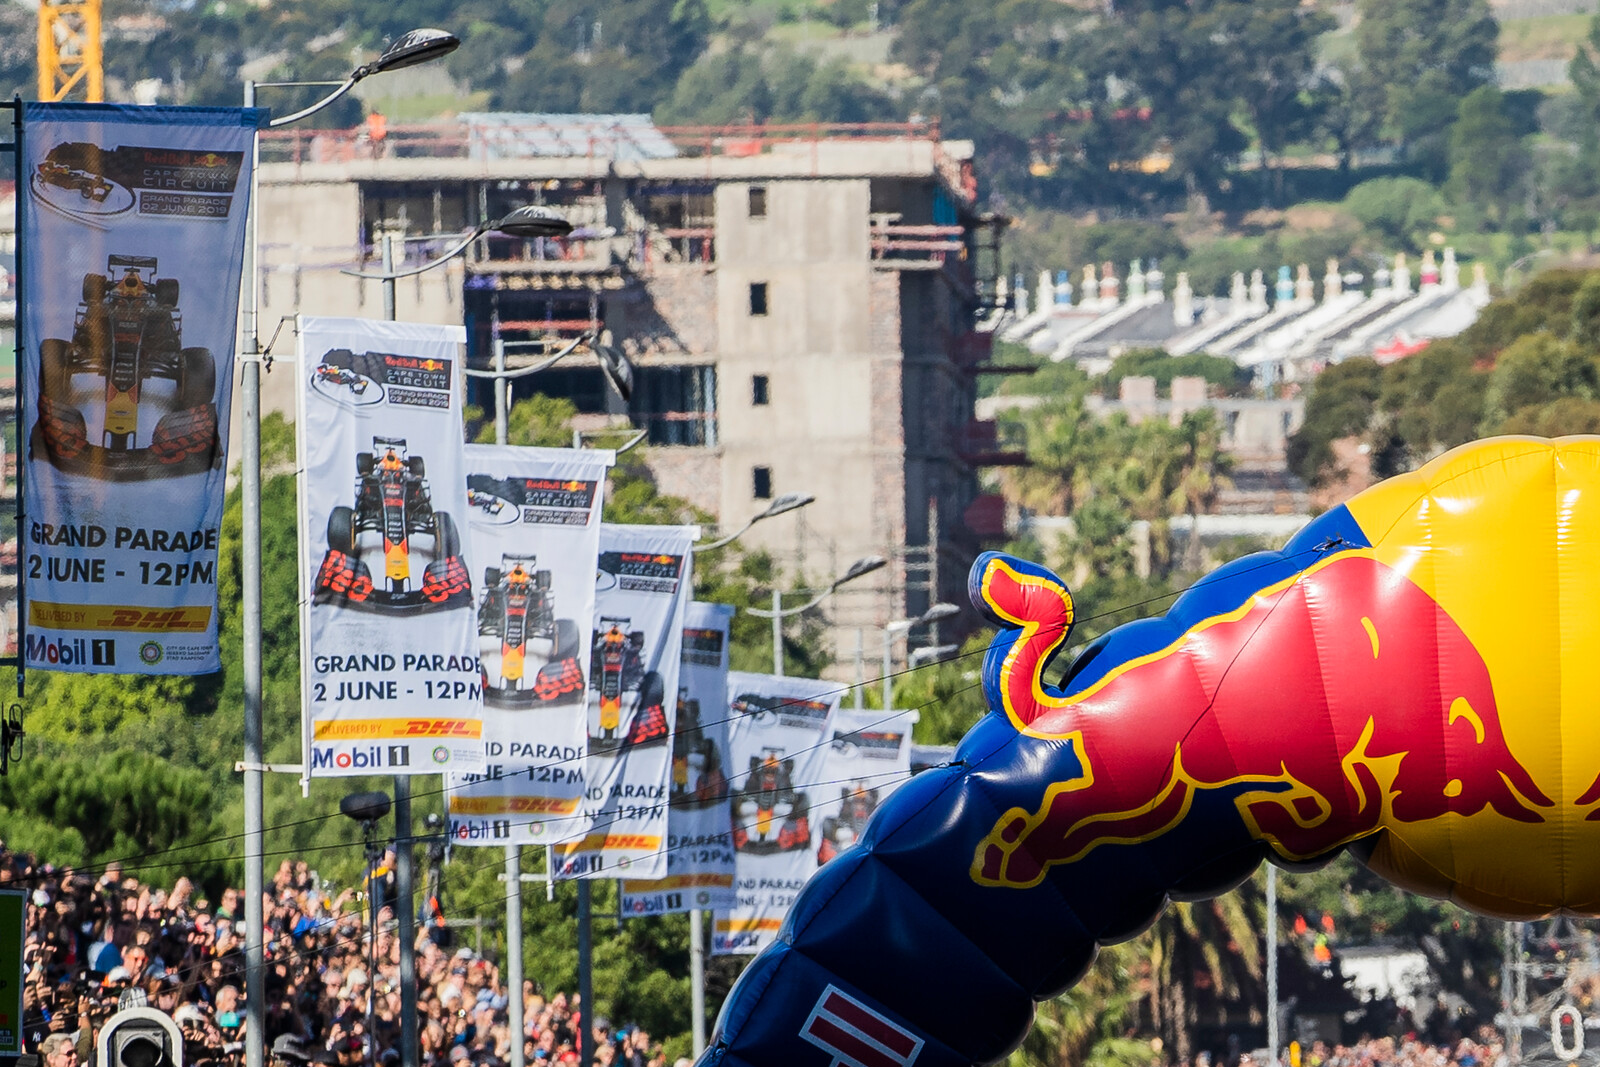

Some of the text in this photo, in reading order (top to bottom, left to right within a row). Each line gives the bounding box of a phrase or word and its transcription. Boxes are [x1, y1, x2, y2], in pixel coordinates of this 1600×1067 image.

[143, 169, 229, 179] CAPE TOWN
[143, 178, 228, 188] CIRCUIT
[142, 194, 227, 205] GRAND PARADE
[161, 204, 196, 213] JUNE
[198, 206, 227, 214] 2019
[388, 376, 446, 388] CIRCUIT
[31, 522, 216, 552] GRAND PARADE
[28, 554, 42, 579] 2
[48, 557, 105, 582] JUNE
[140, 561, 214, 586] 12PM
[36, 608, 192, 628] DELIVERED BY DHL
[26, 634, 86, 665] Mobil
[314, 655, 481, 674] GRAND PARADE
[314, 683, 326, 701] 2
[336, 681, 397, 700] JUNE
[322, 721, 472, 735] DELIVERED BY DHL
[313, 746, 381, 768] Mobil
[528, 766, 584, 784] 12PM
[508, 800, 567, 811] DHL
